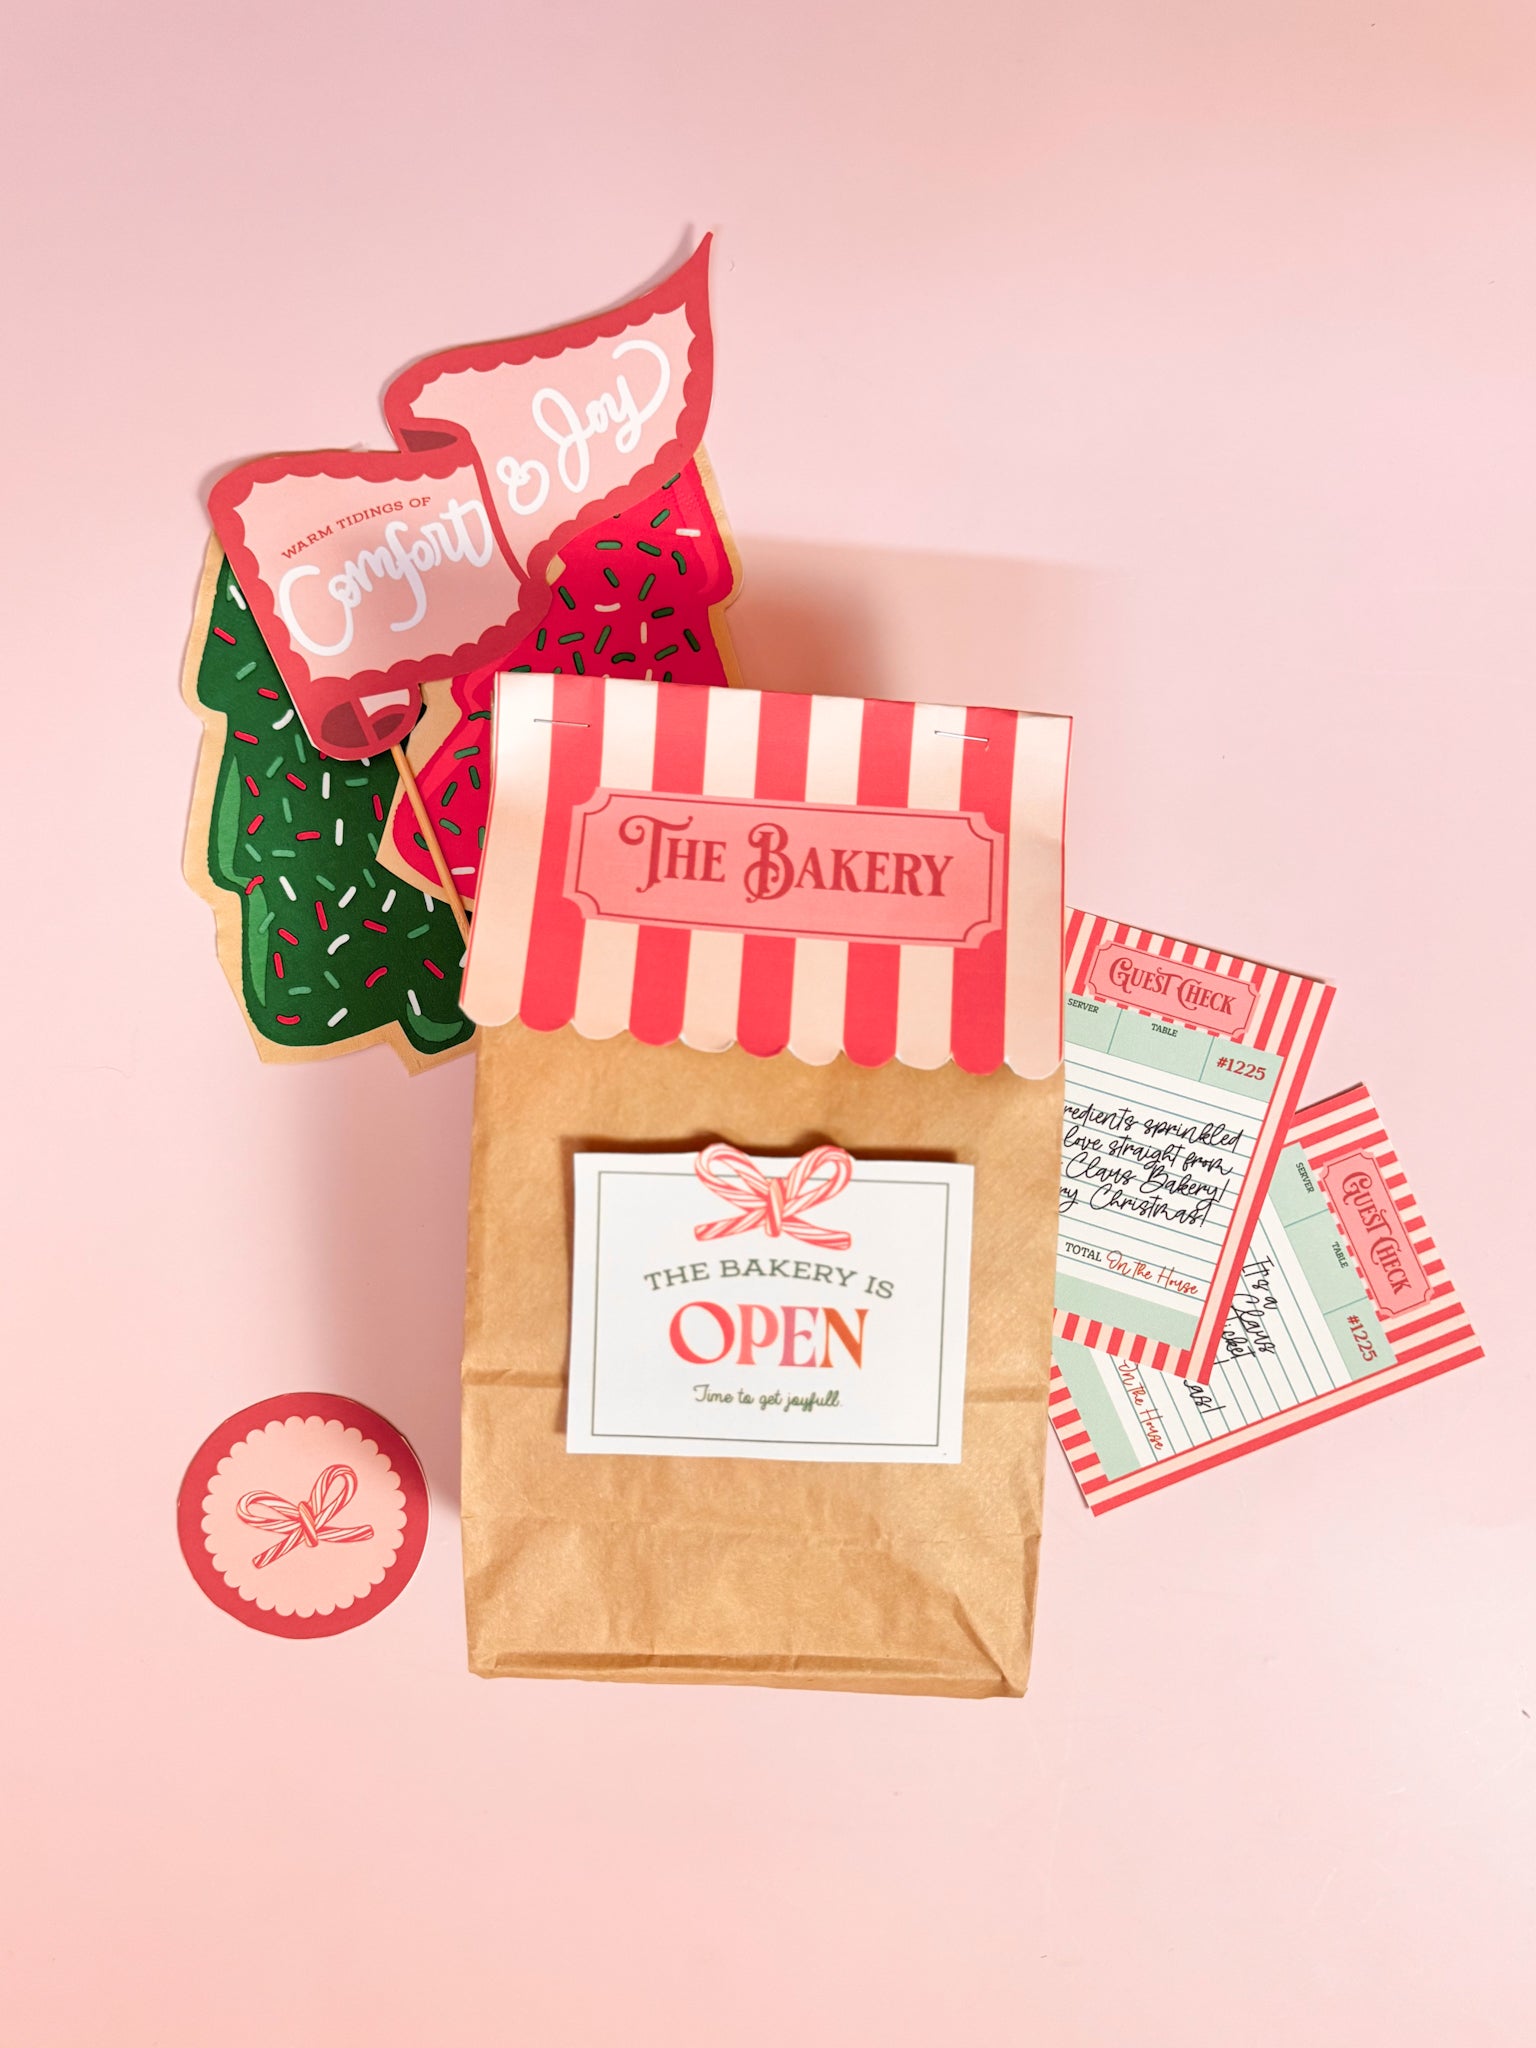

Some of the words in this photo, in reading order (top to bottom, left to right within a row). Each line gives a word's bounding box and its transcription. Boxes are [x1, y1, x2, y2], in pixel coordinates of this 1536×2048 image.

[278, 498, 494, 657] Comfort
[497, 456, 550, 515] &
[531, 339, 671, 493] Joy
[281, 525, 334, 559] WARM
[336, 500, 404, 530] TIDINGS
[409, 496, 431, 509] OF
[1067, 998, 1099, 1014] SERVER
[1109, 957, 1183, 995] GUEST
[1177, 978, 1237, 1015] CHECK
[1151, 1023, 1178, 1038] TABLE
[1216, 1056, 1267, 1081] #1225
[1064, 1125, 1103, 1150] love
[1109, 1135, 1185, 1170] straight
[1182, 1152, 1233, 1175] from
[1143, 1122, 1244, 1153] sprinkled
[1066, 1151, 1136, 1185] Claus
[1139, 1164, 1230, 1211] Bakery!
[1296, 1162, 1314, 1193] SERVER
[1090, 1183, 1212, 1228] Christmas!
[1065, 1242, 1102, 1262] TOTAL
[1106, 1250, 1131, 1276] On
[1157, 1267, 1198, 1295] House
[1331, 1241, 1349, 1269] TABLE
[1370, 1236, 1412, 1295] CHECK
[643, 1262, 710, 1291] THE
[720, 1259, 858, 1287] BAKERY
[864, 1275, 894, 1299] IS
[1263, 1296, 1278, 1309] a
[669, 1301, 869, 1370] OPEN
[1346, 1314, 1378, 1362] #1225
[693, 1384, 734, 1404] Time
[737, 1388, 754, 1404] to
[759, 1389, 782, 1411] get
[1139, 1409, 1163, 1450] House
